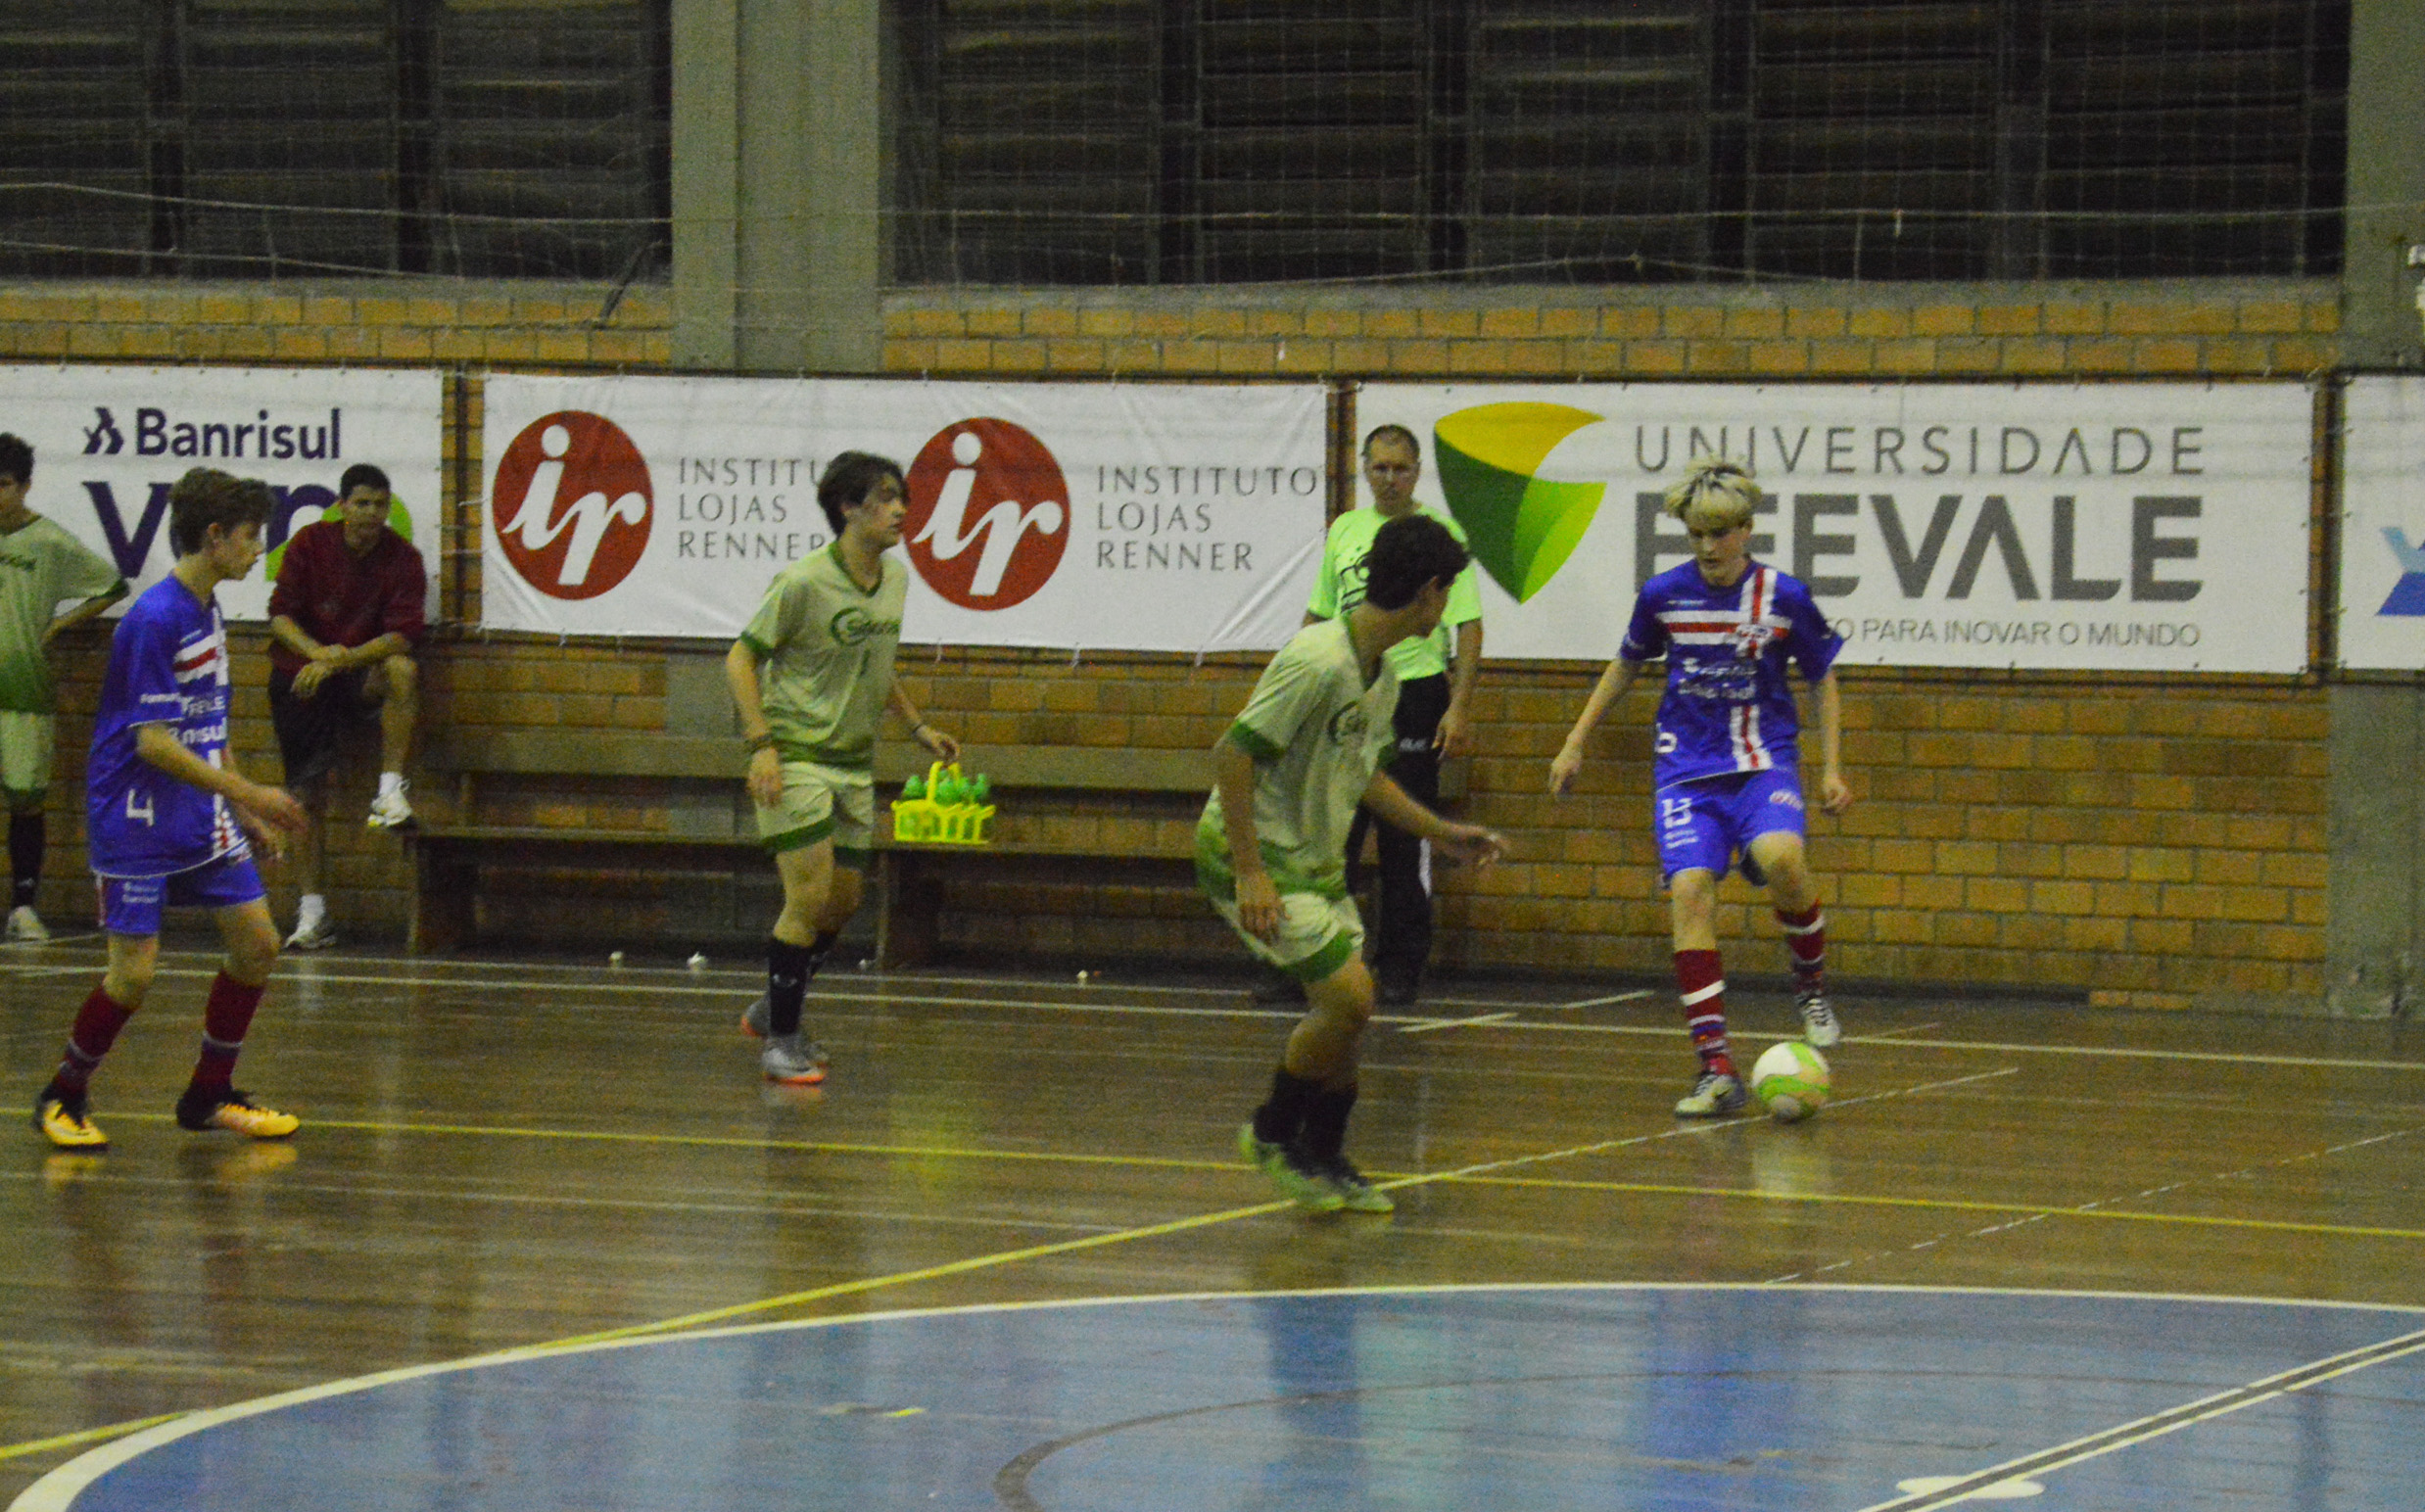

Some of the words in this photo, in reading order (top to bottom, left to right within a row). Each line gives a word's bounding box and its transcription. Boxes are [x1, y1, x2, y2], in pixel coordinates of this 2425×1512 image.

[136, 407, 341, 459] Banrisul
[1636, 425, 2204, 476] UNIVERSIDADE
[1098, 465, 1318, 496] INSTITUTO
[678, 493, 787, 525] LOJAS
[1098, 501, 1212, 536] LOJAS
[1097, 541, 1254, 572] RENNER
[1863, 618, 1937, 643] PARA
[1944, 619, 2051, 645] INOVAR
[2059, 621, 2080, 646] O
[2087, 622, 2202, 647] MUNDO
[125, 788, 155, 827] 4
